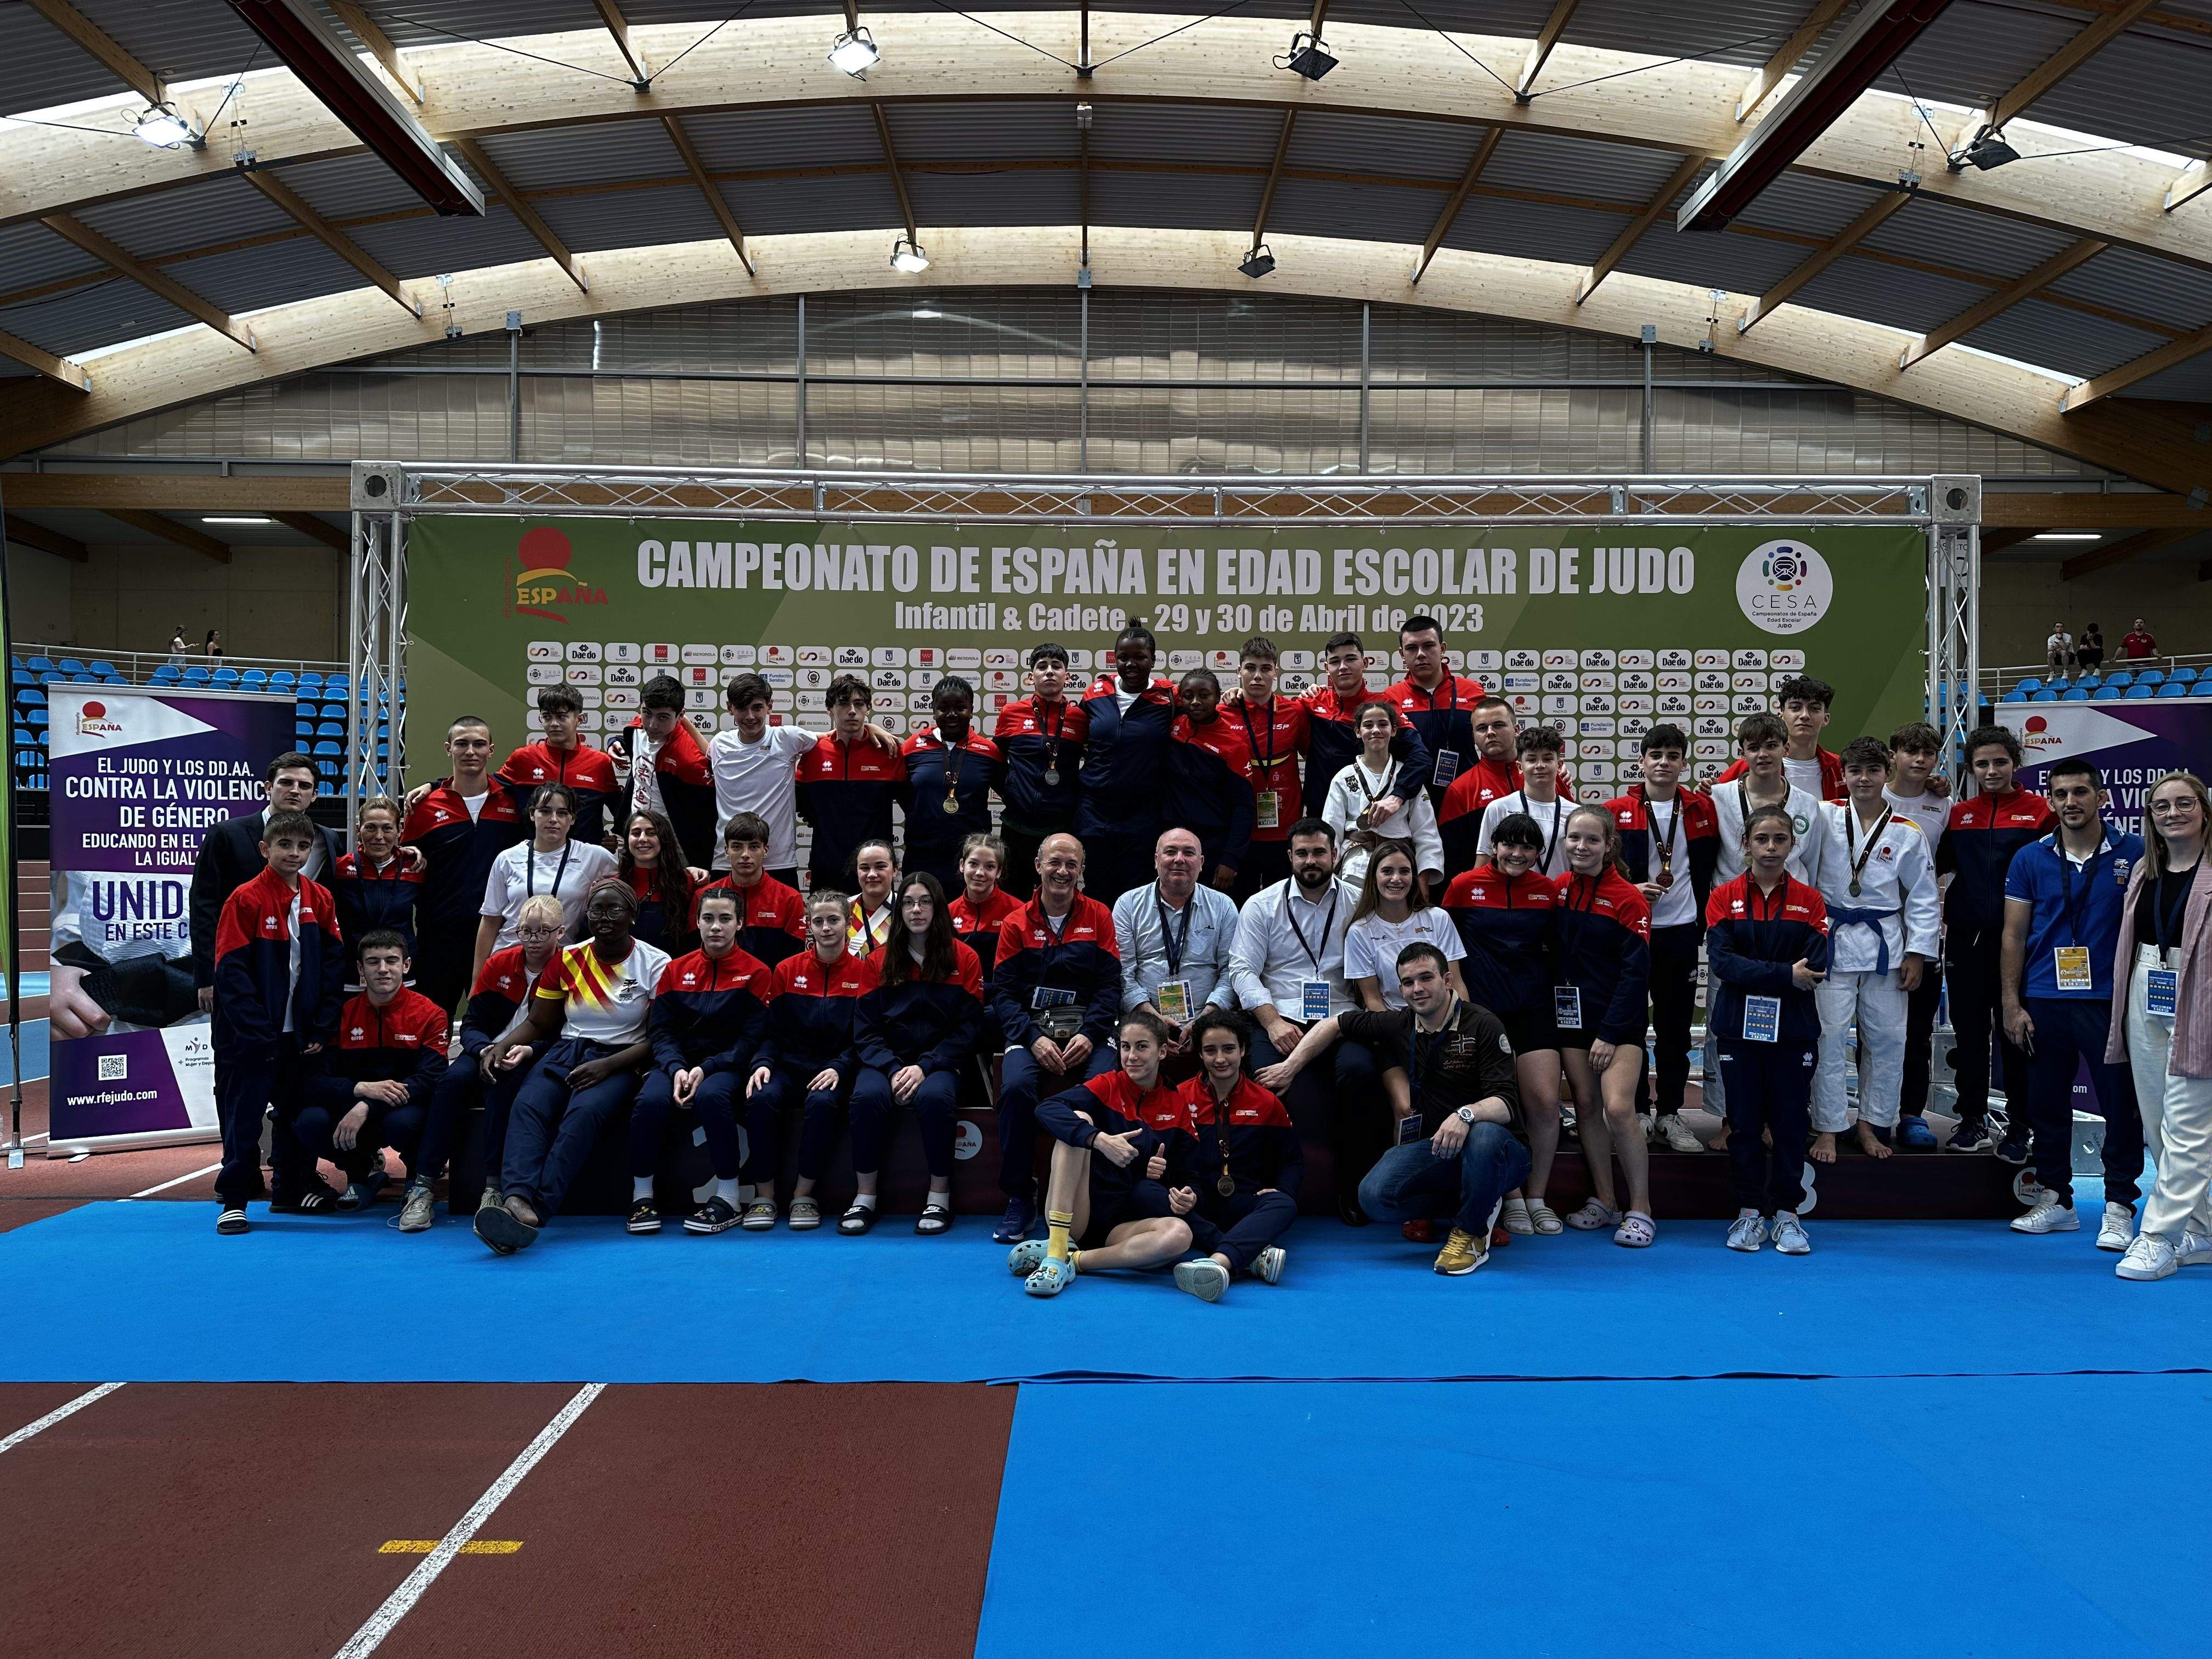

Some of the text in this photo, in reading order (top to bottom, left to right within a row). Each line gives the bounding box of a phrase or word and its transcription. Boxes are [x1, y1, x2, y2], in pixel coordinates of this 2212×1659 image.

[637, 539, 1695, 595] CAMPEONATO DE ESPAÑA EN EDAD ESCOLAR DE JUDO
[1752, 595, 1816, 608] CESA
[896, 602, 997, 630] Infantil
[1003, 606, 1022, 631] &
[1028, 603, 1126, 631] Cadete
[1155, 603, 1189, 632] 29
[1195, 609, 1211, 635] y
[1217, 603, 1252, 632] 30
[1259, 605, 1293, 632] de
[1300, 605, 1365, 632] Abril
[1372, 605, 1407, 633] de
[98, 757, 254, 777] EL JUDO Y LOS DD.AA.
[2100, 769, 2111, 785] Y
[2114, 769, 2142, 785] LOS
[66, 776, 270, 802] CONTRA LA VIOLENC
[120, 802, 229, 828] DE GÉNERO
[82, 833, 156, 848] EDUCANDO
[161, 834, 178, 848] EN
[182, 834, 198, 848] EL
[136, 851, 197, 866] LA IGUAL
[93, 881, 184, 922] UNID
[105, 923, 126, 941] EN
[133, 922, 172, 940] ESTE
[67, 1090, 157, 1105] www.rfejudo.com
